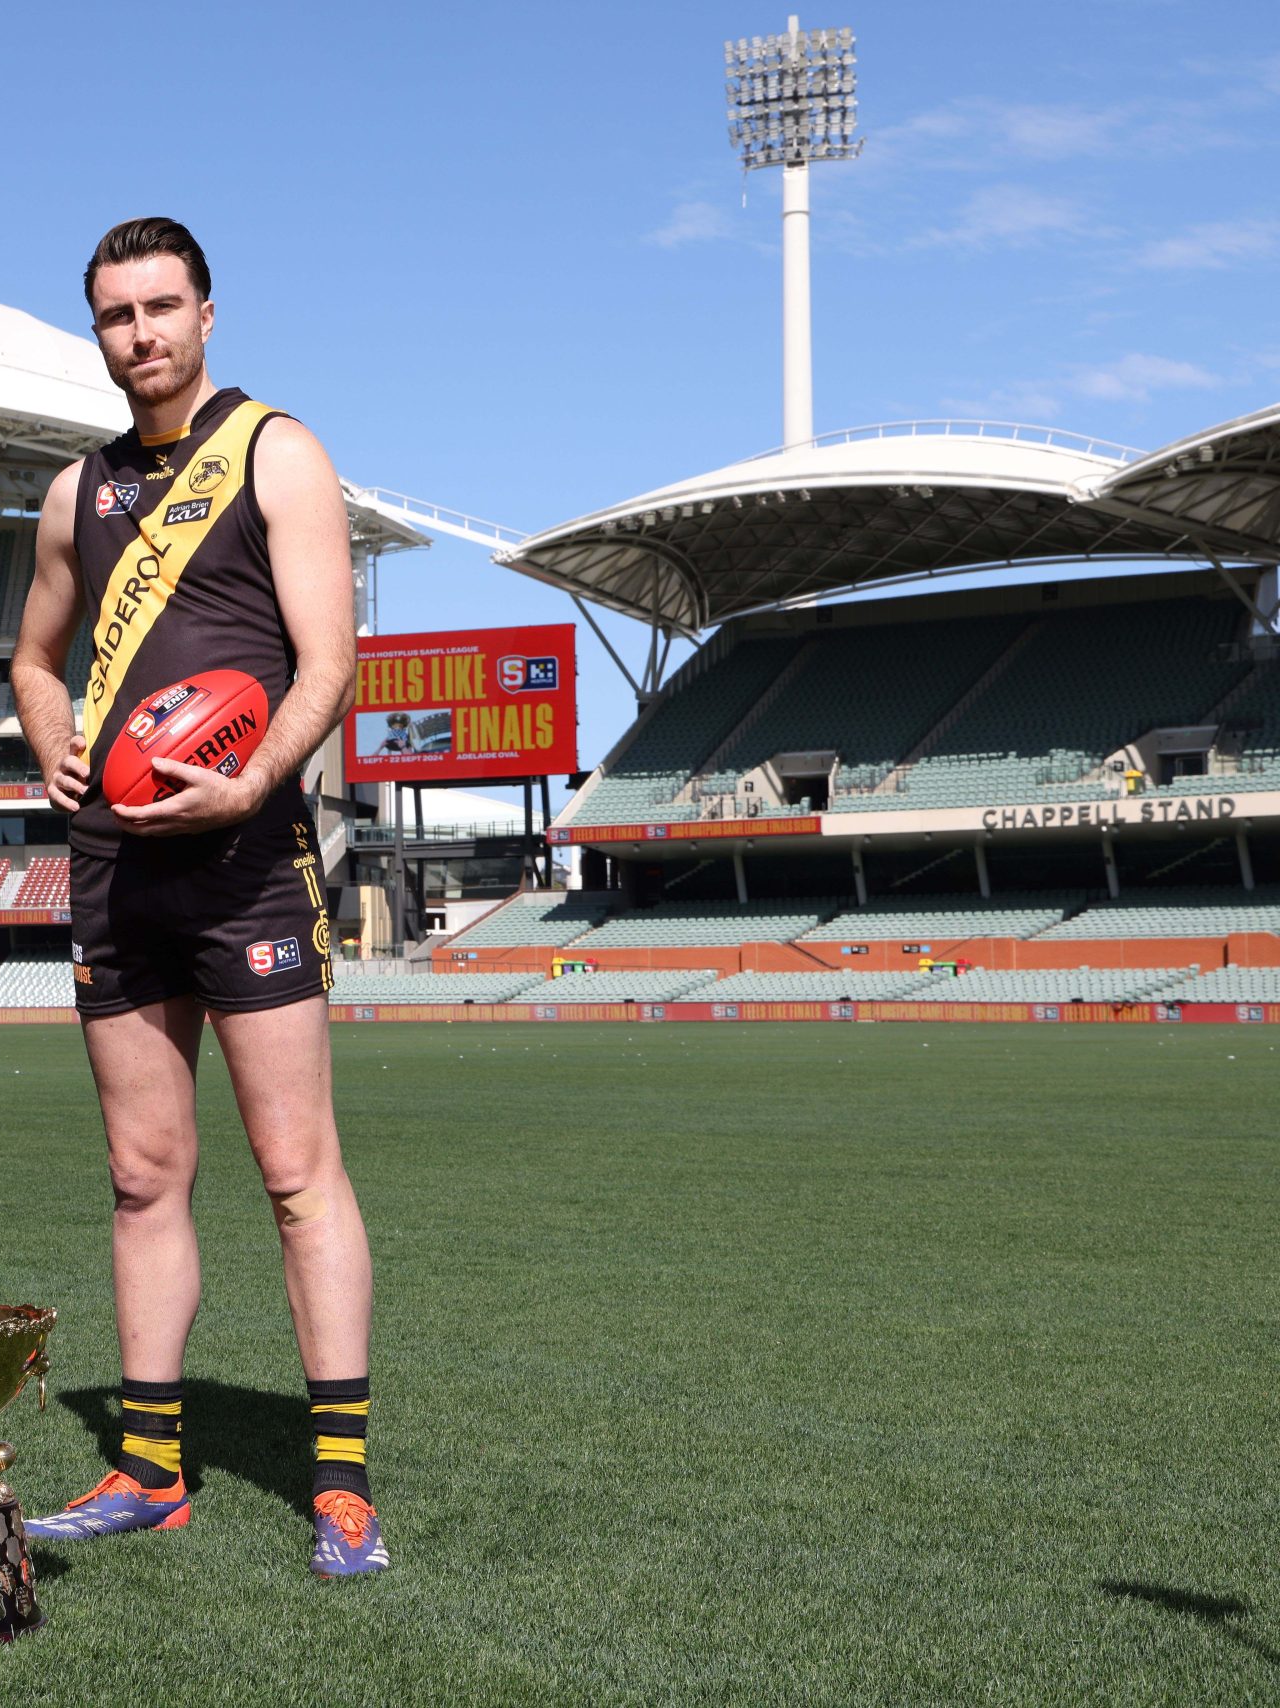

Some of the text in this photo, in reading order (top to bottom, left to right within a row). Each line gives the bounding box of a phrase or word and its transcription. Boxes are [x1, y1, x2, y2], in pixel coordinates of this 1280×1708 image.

[169, 501, 209, 514] Adrian Brien
[377, 649, 418, 658] HOSTPLUS
[419, 647, 445, 656] SANFL
[447, 645, 479, 654] LEAGUE
[355, 653, 487, 705] FEELS LIKE
[152, 684, 184, 708] WEST
[164, 689, 190, 710] END
[456, 703, 554, 753] FINALS
[363, 757, 384, 765] SEPT
[401, 755, 422, 763] SEPT
[422, 754, 444, 762] 2024
[456, 751, 520, 761] ADELAIDE OVAL
[982, 797, 1235, 829] CHAPPELL STAND
